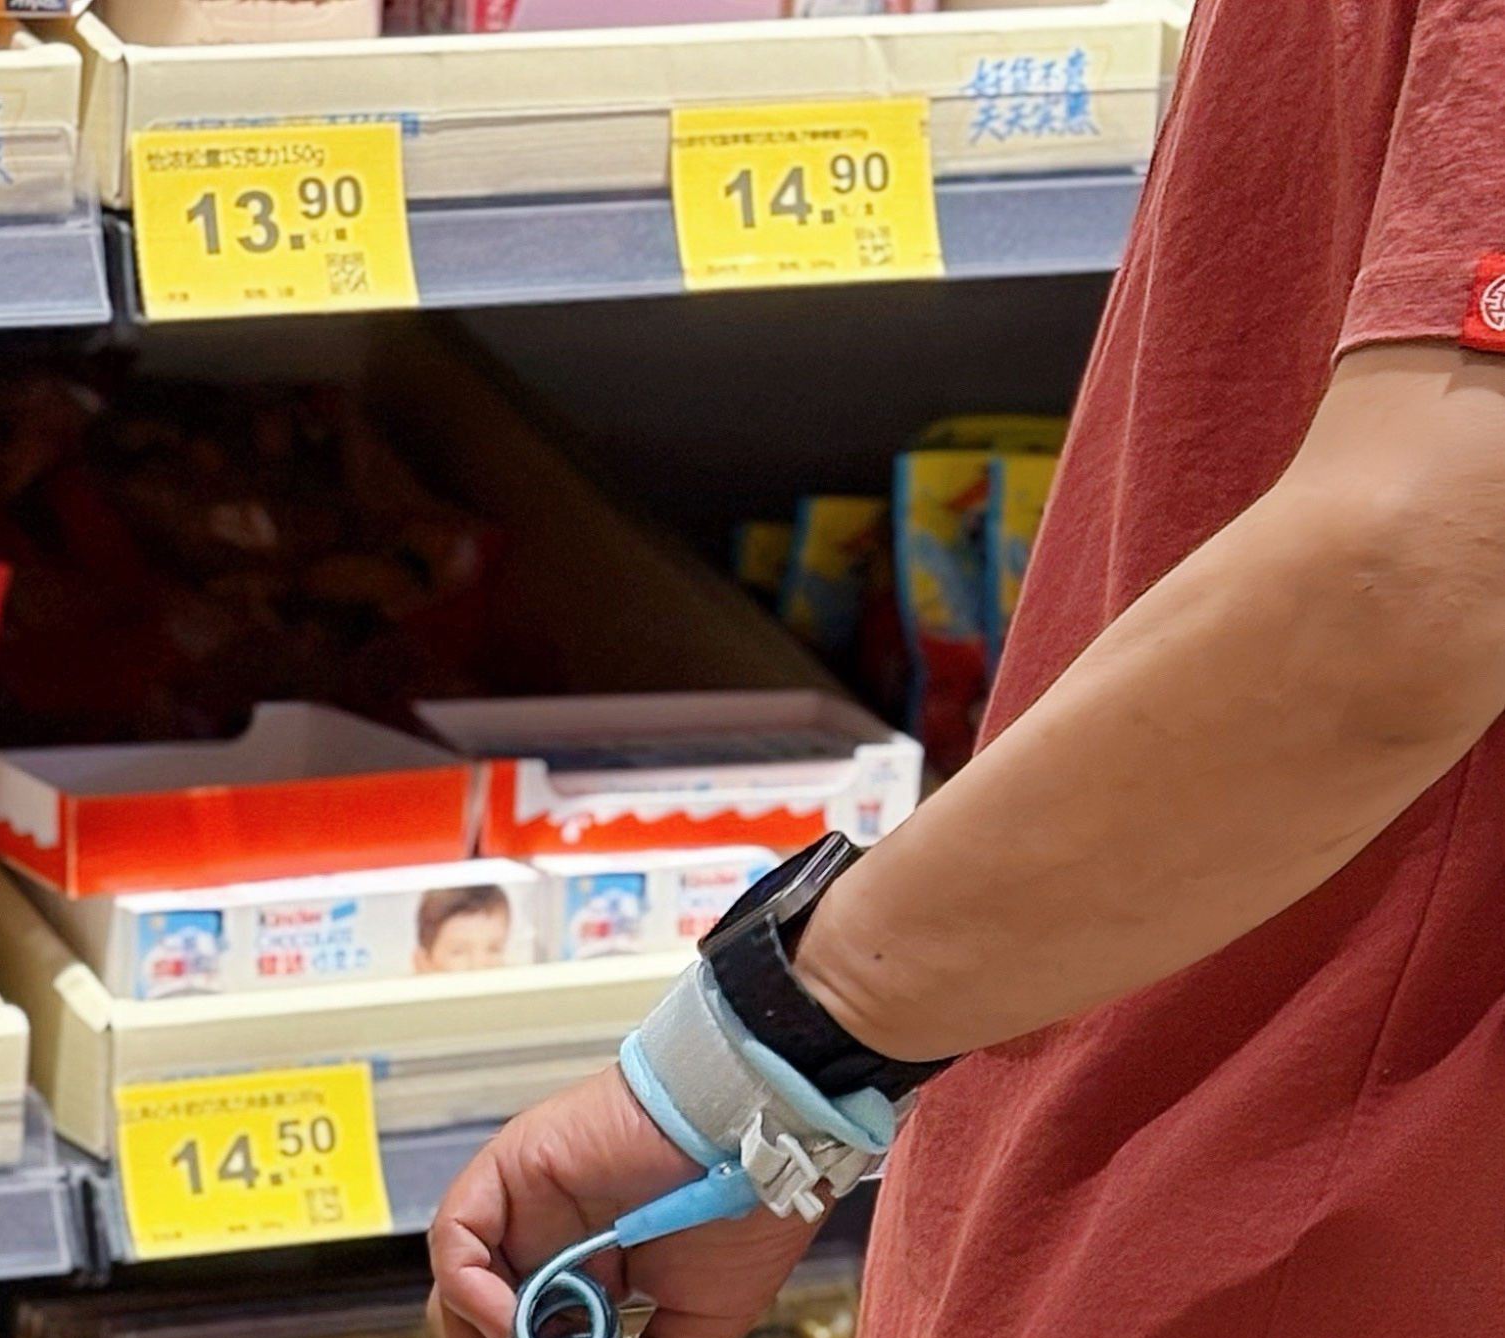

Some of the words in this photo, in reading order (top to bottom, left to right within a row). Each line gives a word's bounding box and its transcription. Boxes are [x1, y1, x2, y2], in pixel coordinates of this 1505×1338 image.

[186, 175, 363, 255] 13.90
[724, 152, 890, 229] 14.90
[171, 1116, 337, 1195] 14.50
